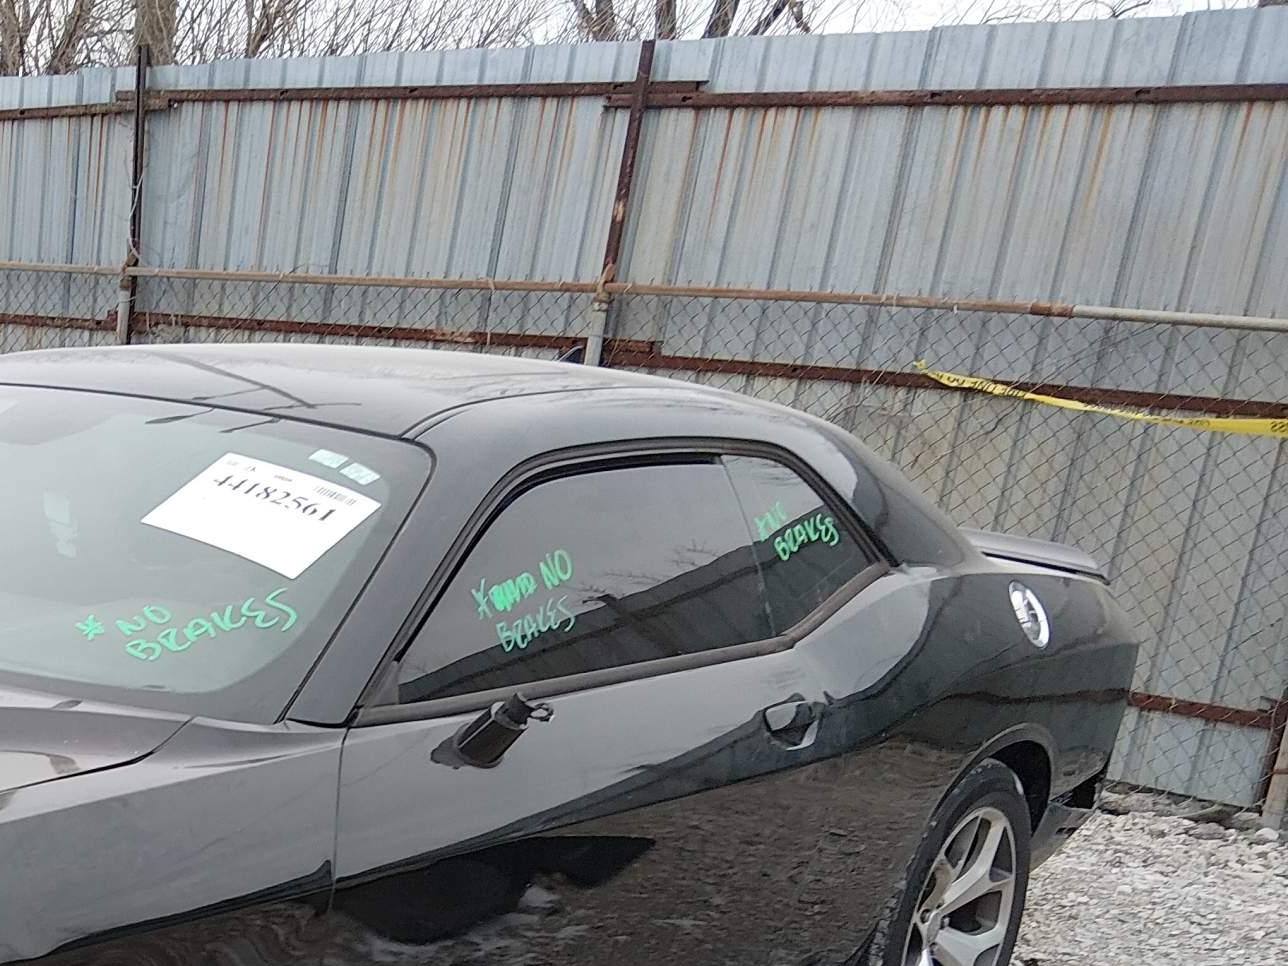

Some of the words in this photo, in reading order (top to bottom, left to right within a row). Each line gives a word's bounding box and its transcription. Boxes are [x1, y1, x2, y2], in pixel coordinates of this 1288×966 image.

[213, 474, 337, 522] 44182561
[773, 513, 839, 561] BRAKES
[539, 549, 572, 590] NO
[115, 604, 172, 635] NO
[125, 587, 298, 661] BRAKES
[496, 595, 576, 653] BRAKES
